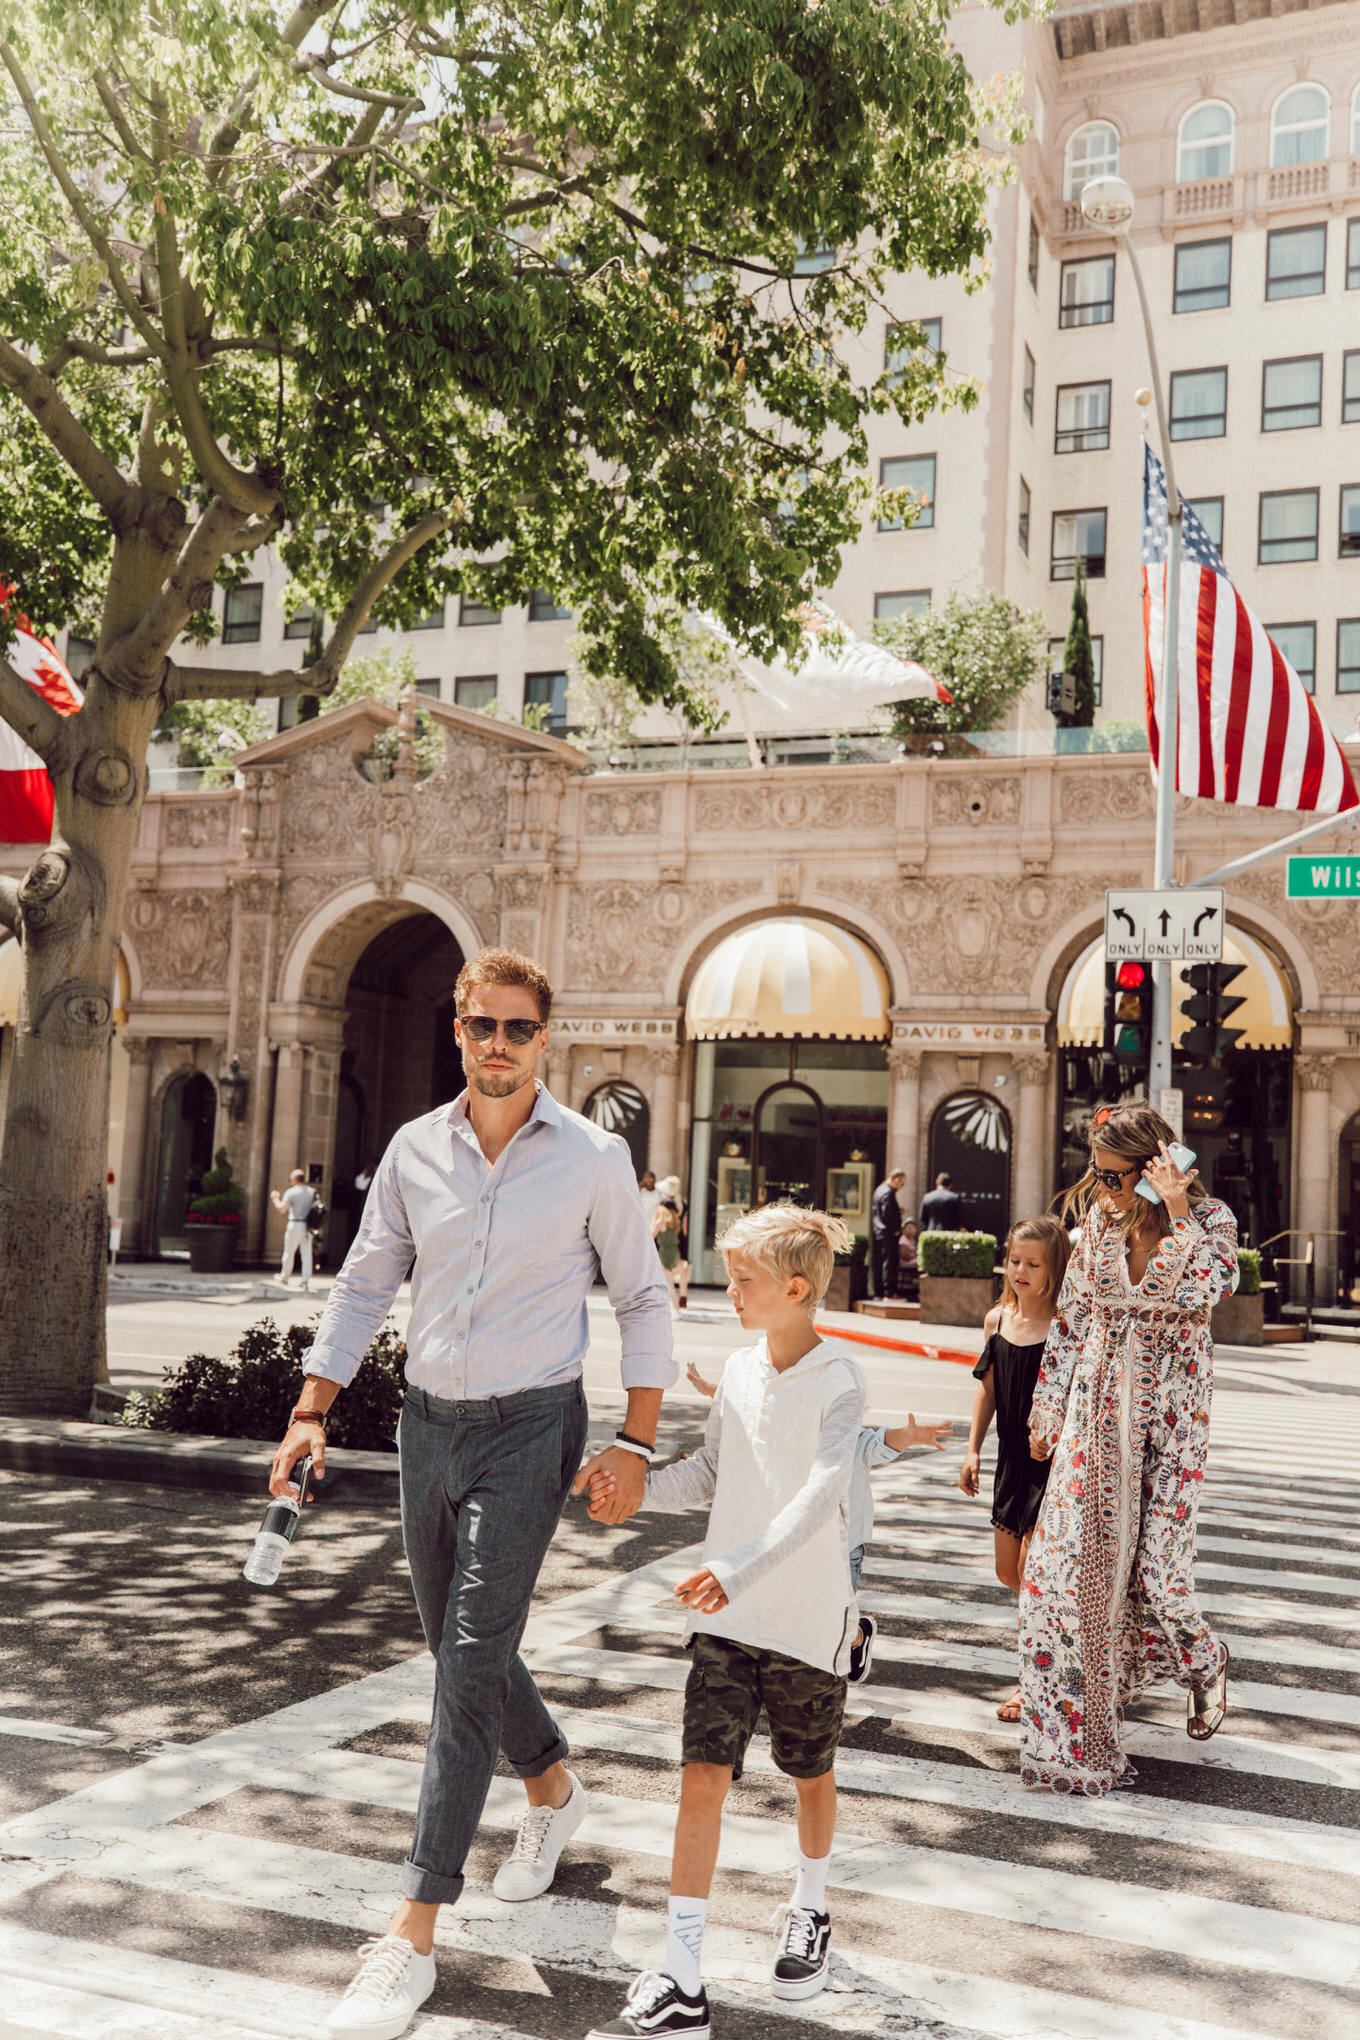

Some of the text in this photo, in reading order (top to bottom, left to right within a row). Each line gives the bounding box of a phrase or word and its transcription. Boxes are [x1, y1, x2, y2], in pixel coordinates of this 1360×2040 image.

[1109, 944, 1141, 954] ONLY
[1147, 944, 1180, 954] ONLY
[1186, 944, 1219, 954] ONLY
[550, 1022, 673, 1034] DAVID WEBB
[895, 1026, 1041, 1041] DAVID WEBB
